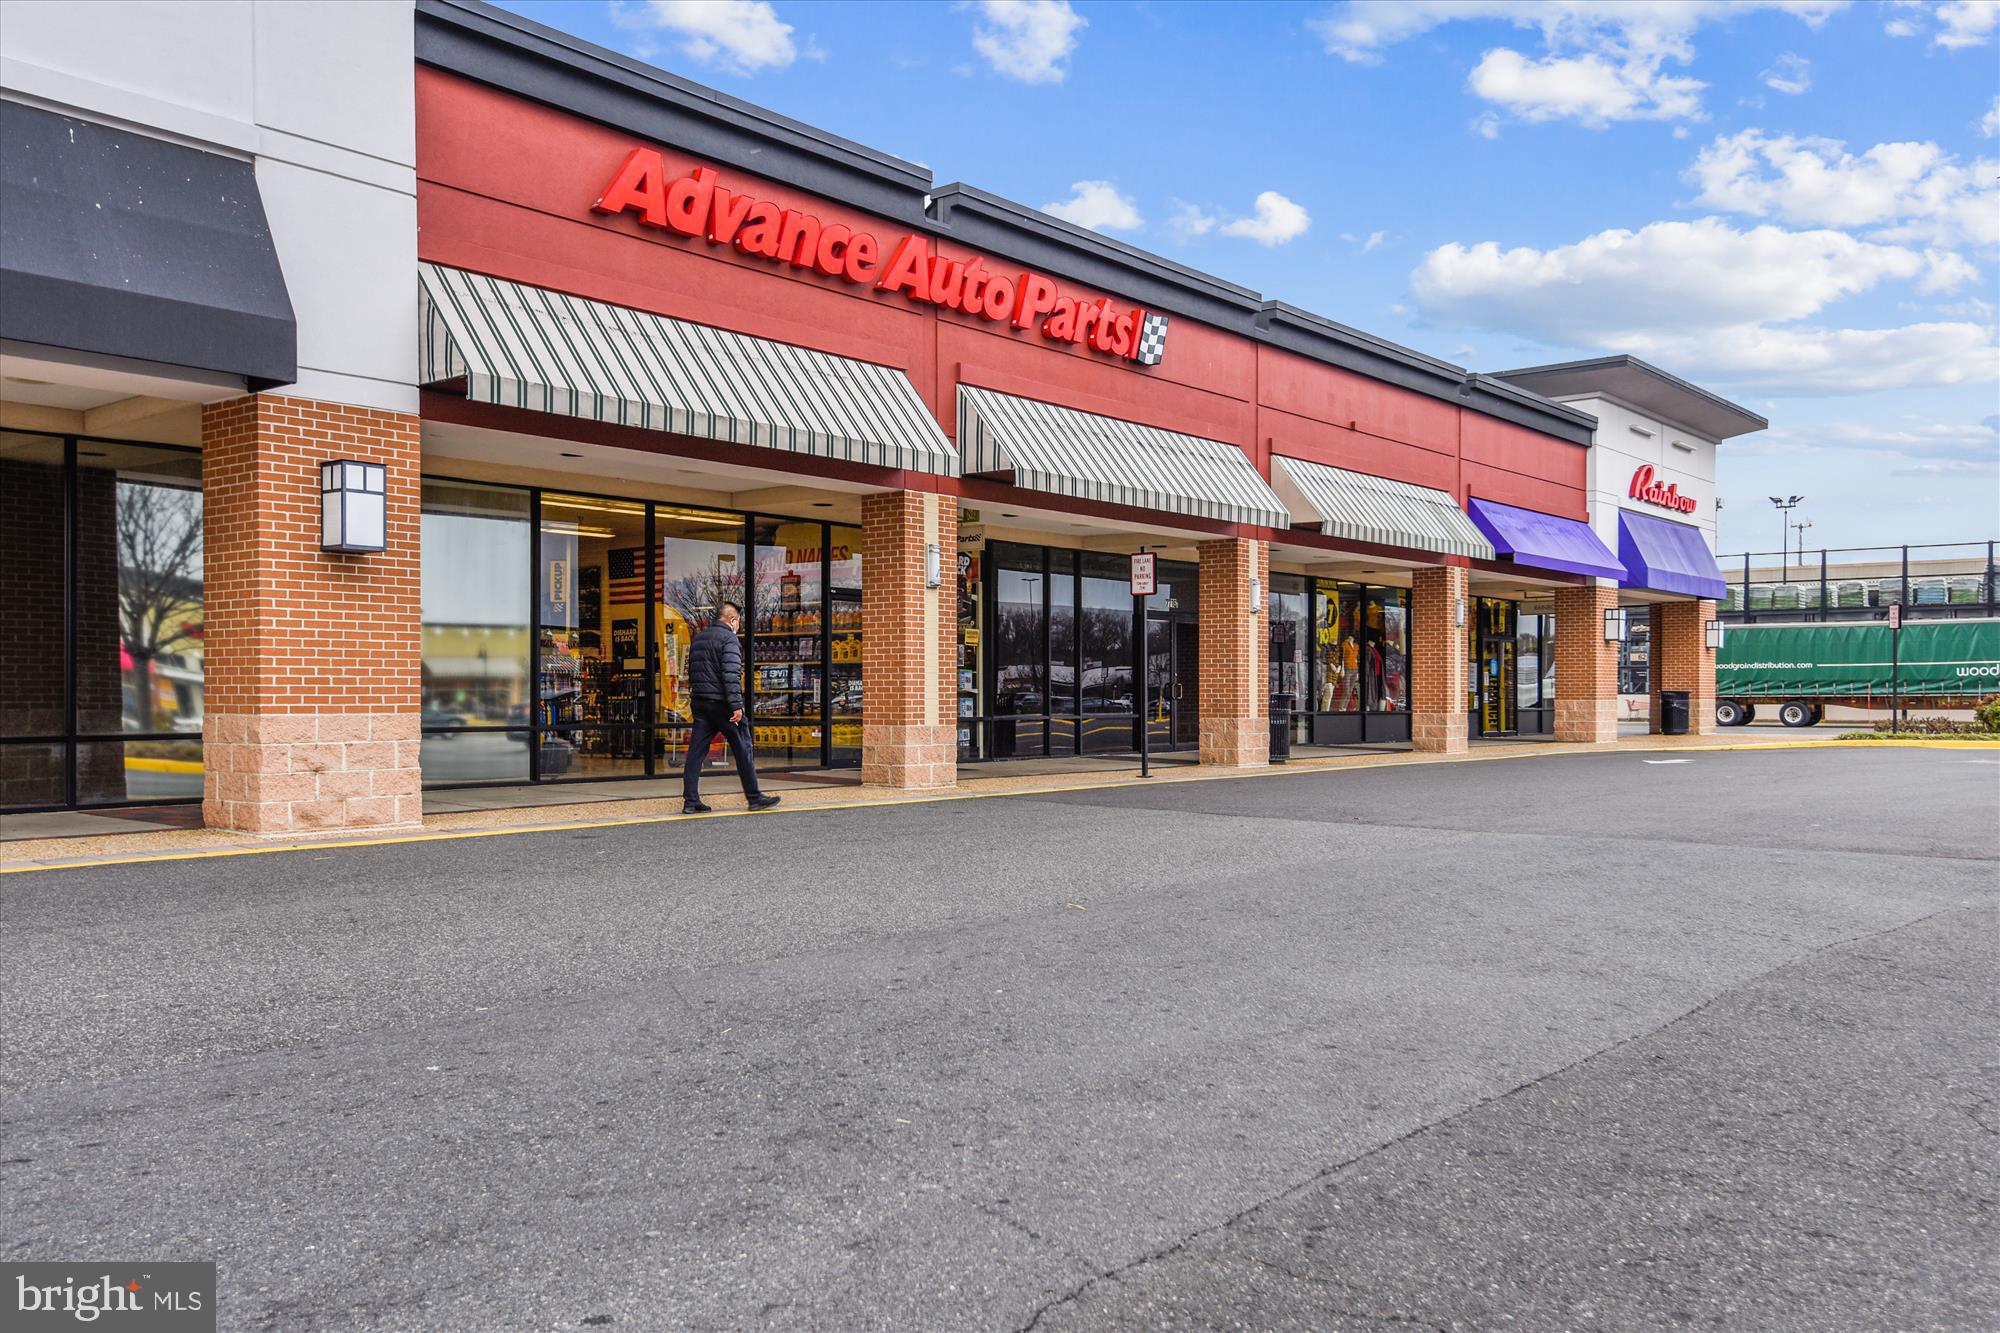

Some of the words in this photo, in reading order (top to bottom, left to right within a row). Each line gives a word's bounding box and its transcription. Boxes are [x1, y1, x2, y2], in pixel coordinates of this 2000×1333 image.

[590, 147, 878, 283] Advance
[873, 234, 1014, 321] Auto
[1010, 272, 1133, 356] Parts
[1629, 464, 1697, 513] Rainbow
[554, 562, 564, 600] PICKUP
[1956, 663, 1999, 677] wood
